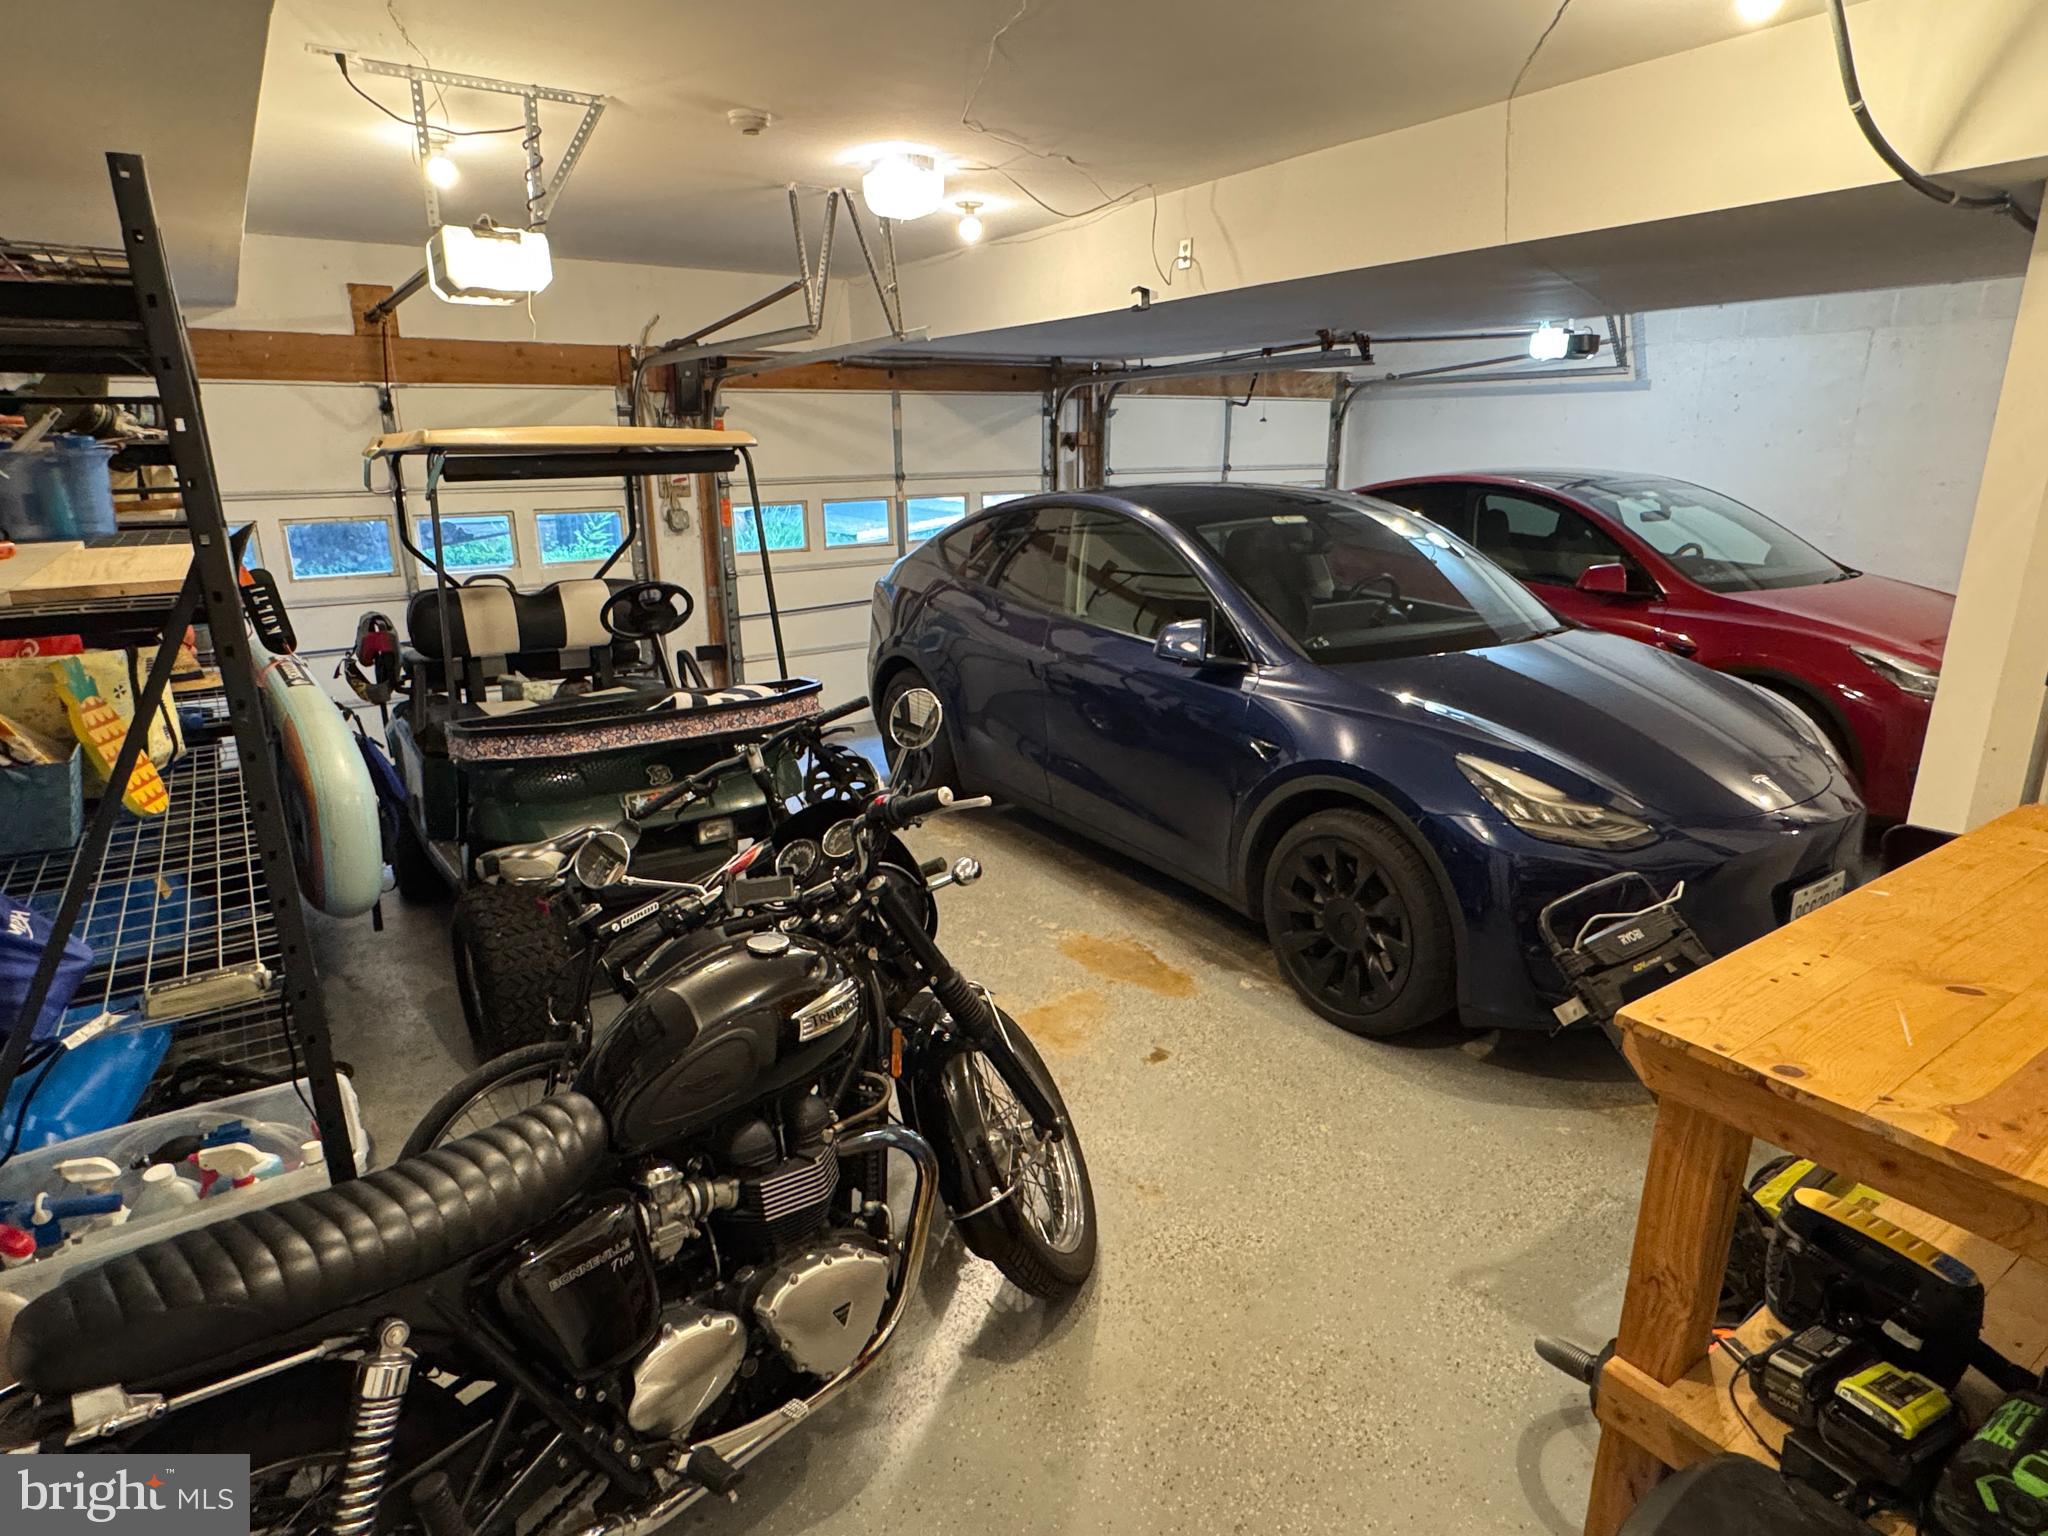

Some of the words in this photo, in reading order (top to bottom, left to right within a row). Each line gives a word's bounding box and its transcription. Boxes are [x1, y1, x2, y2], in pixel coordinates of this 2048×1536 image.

[1617, 928, 1645, 946] RYOBI
[548, 1237, 631, 1292] BONNEVILLE
[610, 1250, 635, 1273] T100
